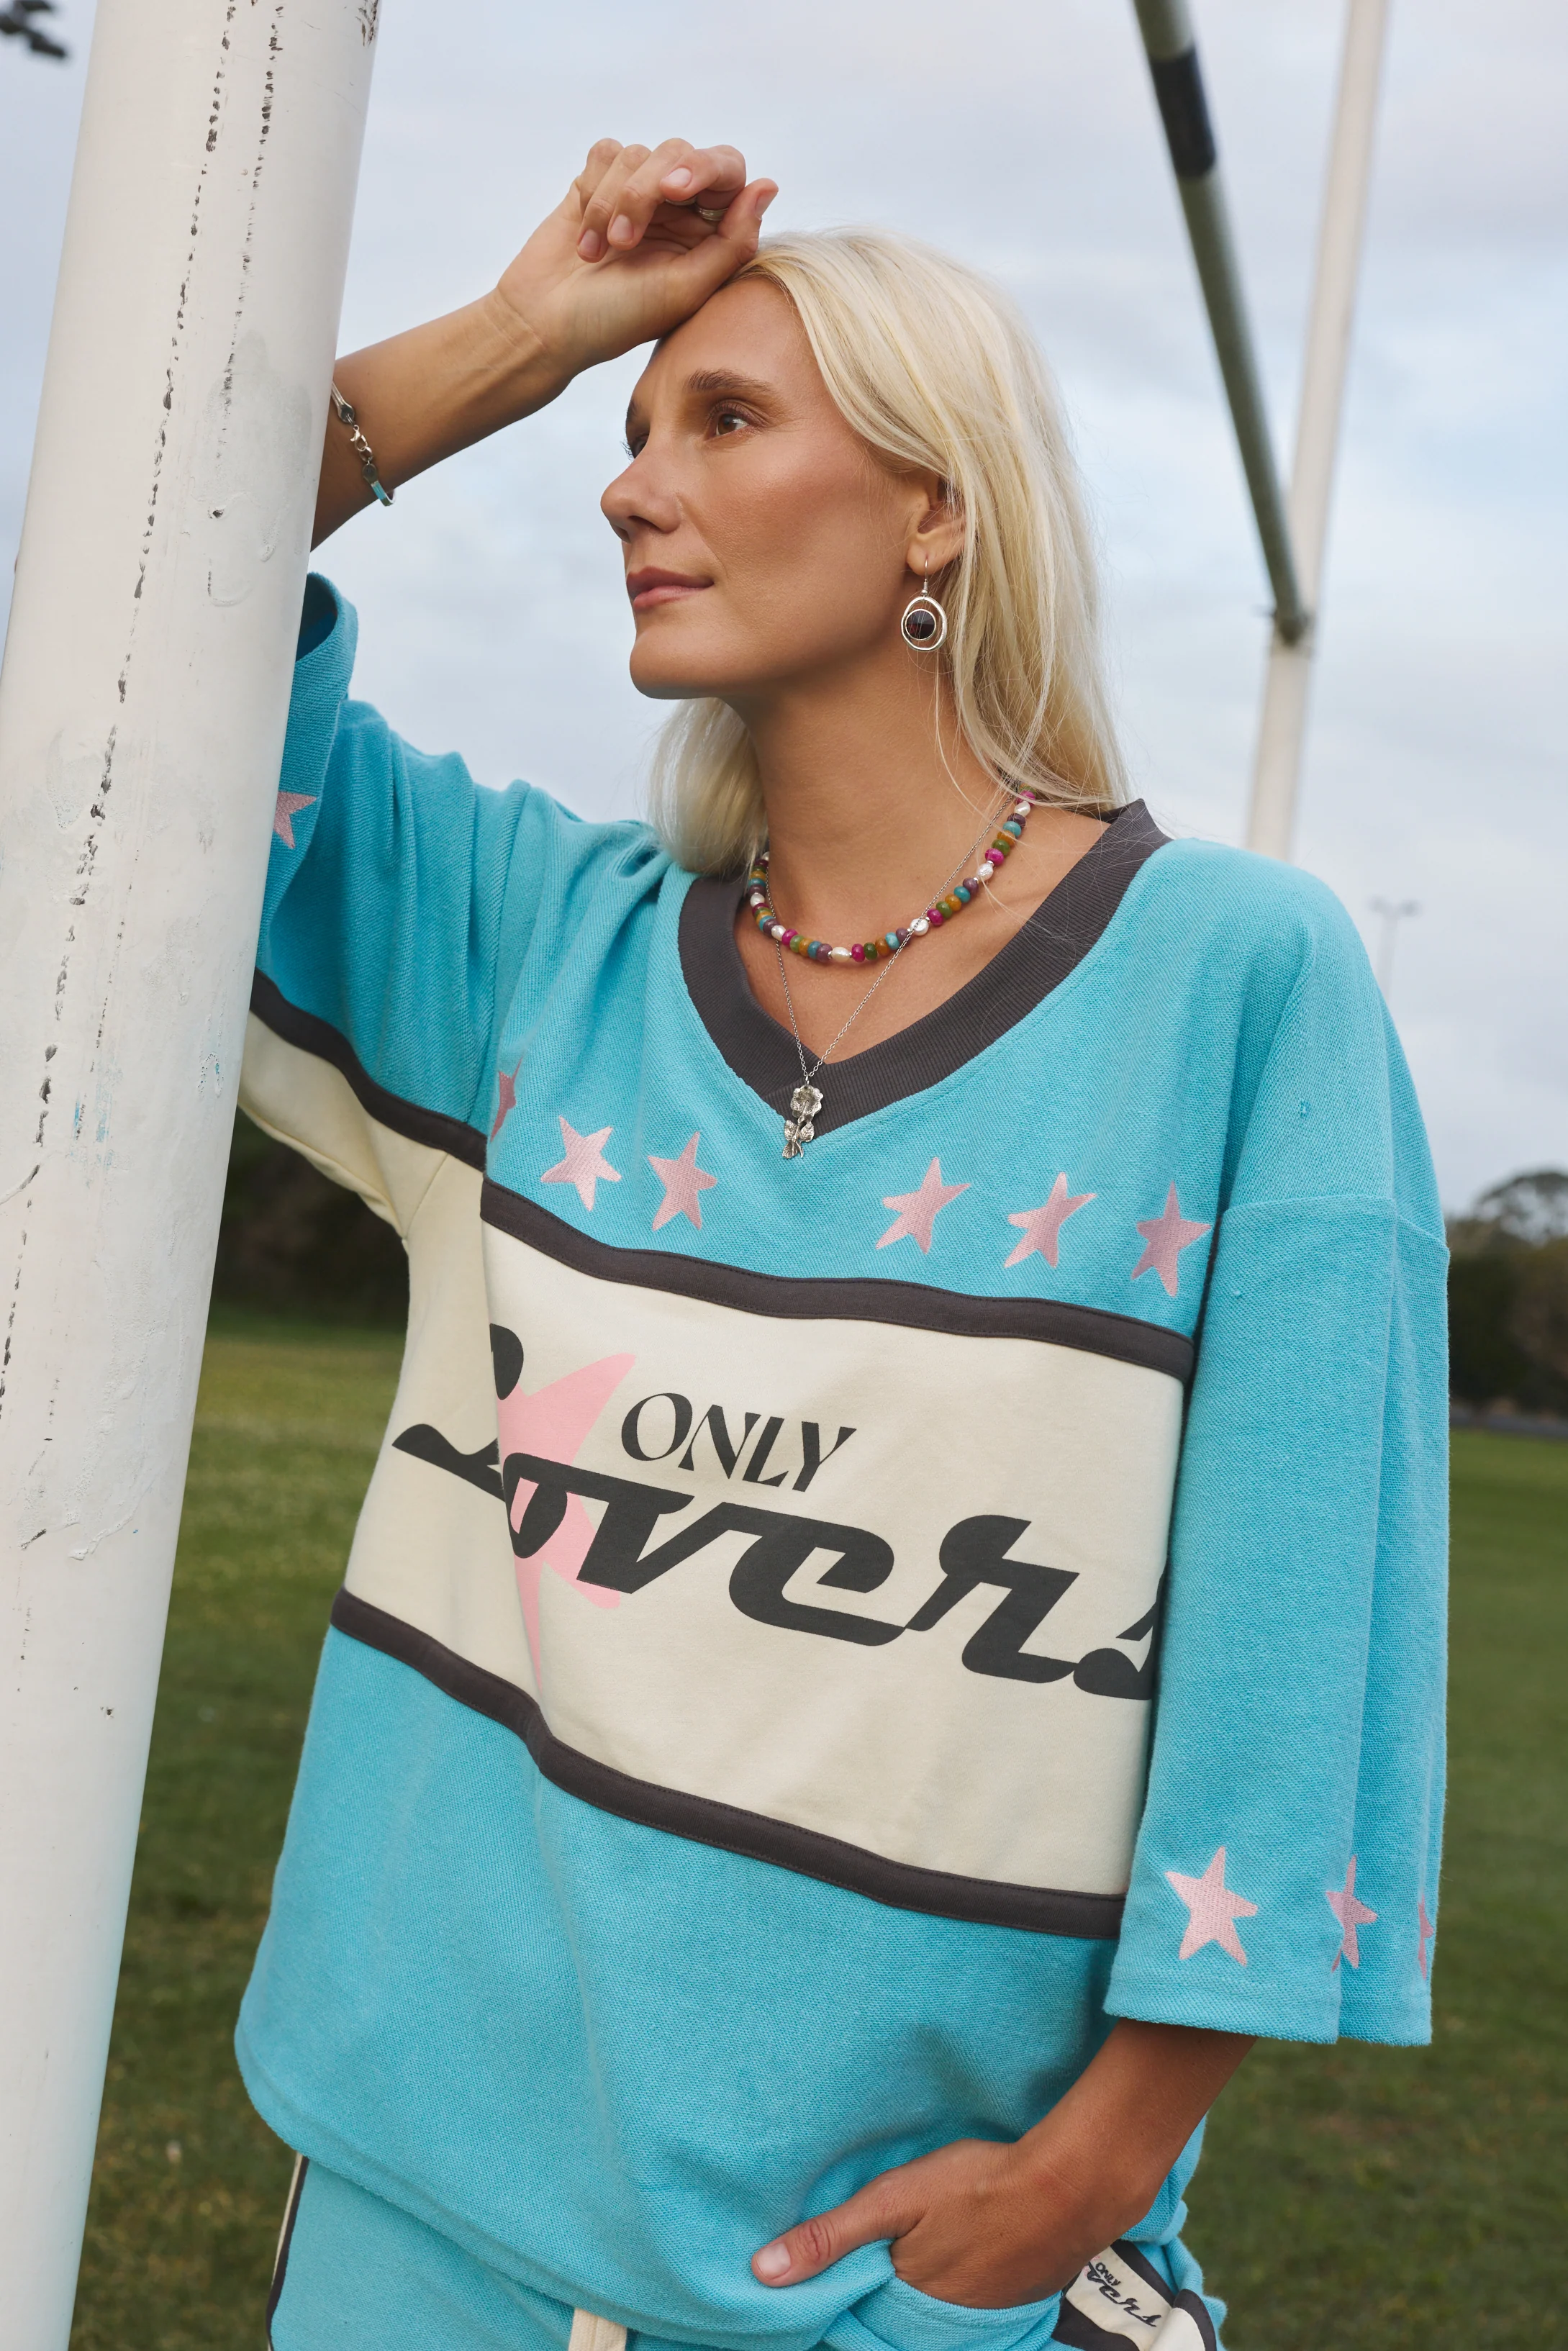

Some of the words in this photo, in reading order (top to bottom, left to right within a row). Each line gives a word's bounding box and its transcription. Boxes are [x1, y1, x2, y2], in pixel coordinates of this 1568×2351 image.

[621, 1392, 856, 1492] ONLY
[1087, 2261, 1161, 2327] vers
[1095, 2262, 1121, 2286] ONLY
